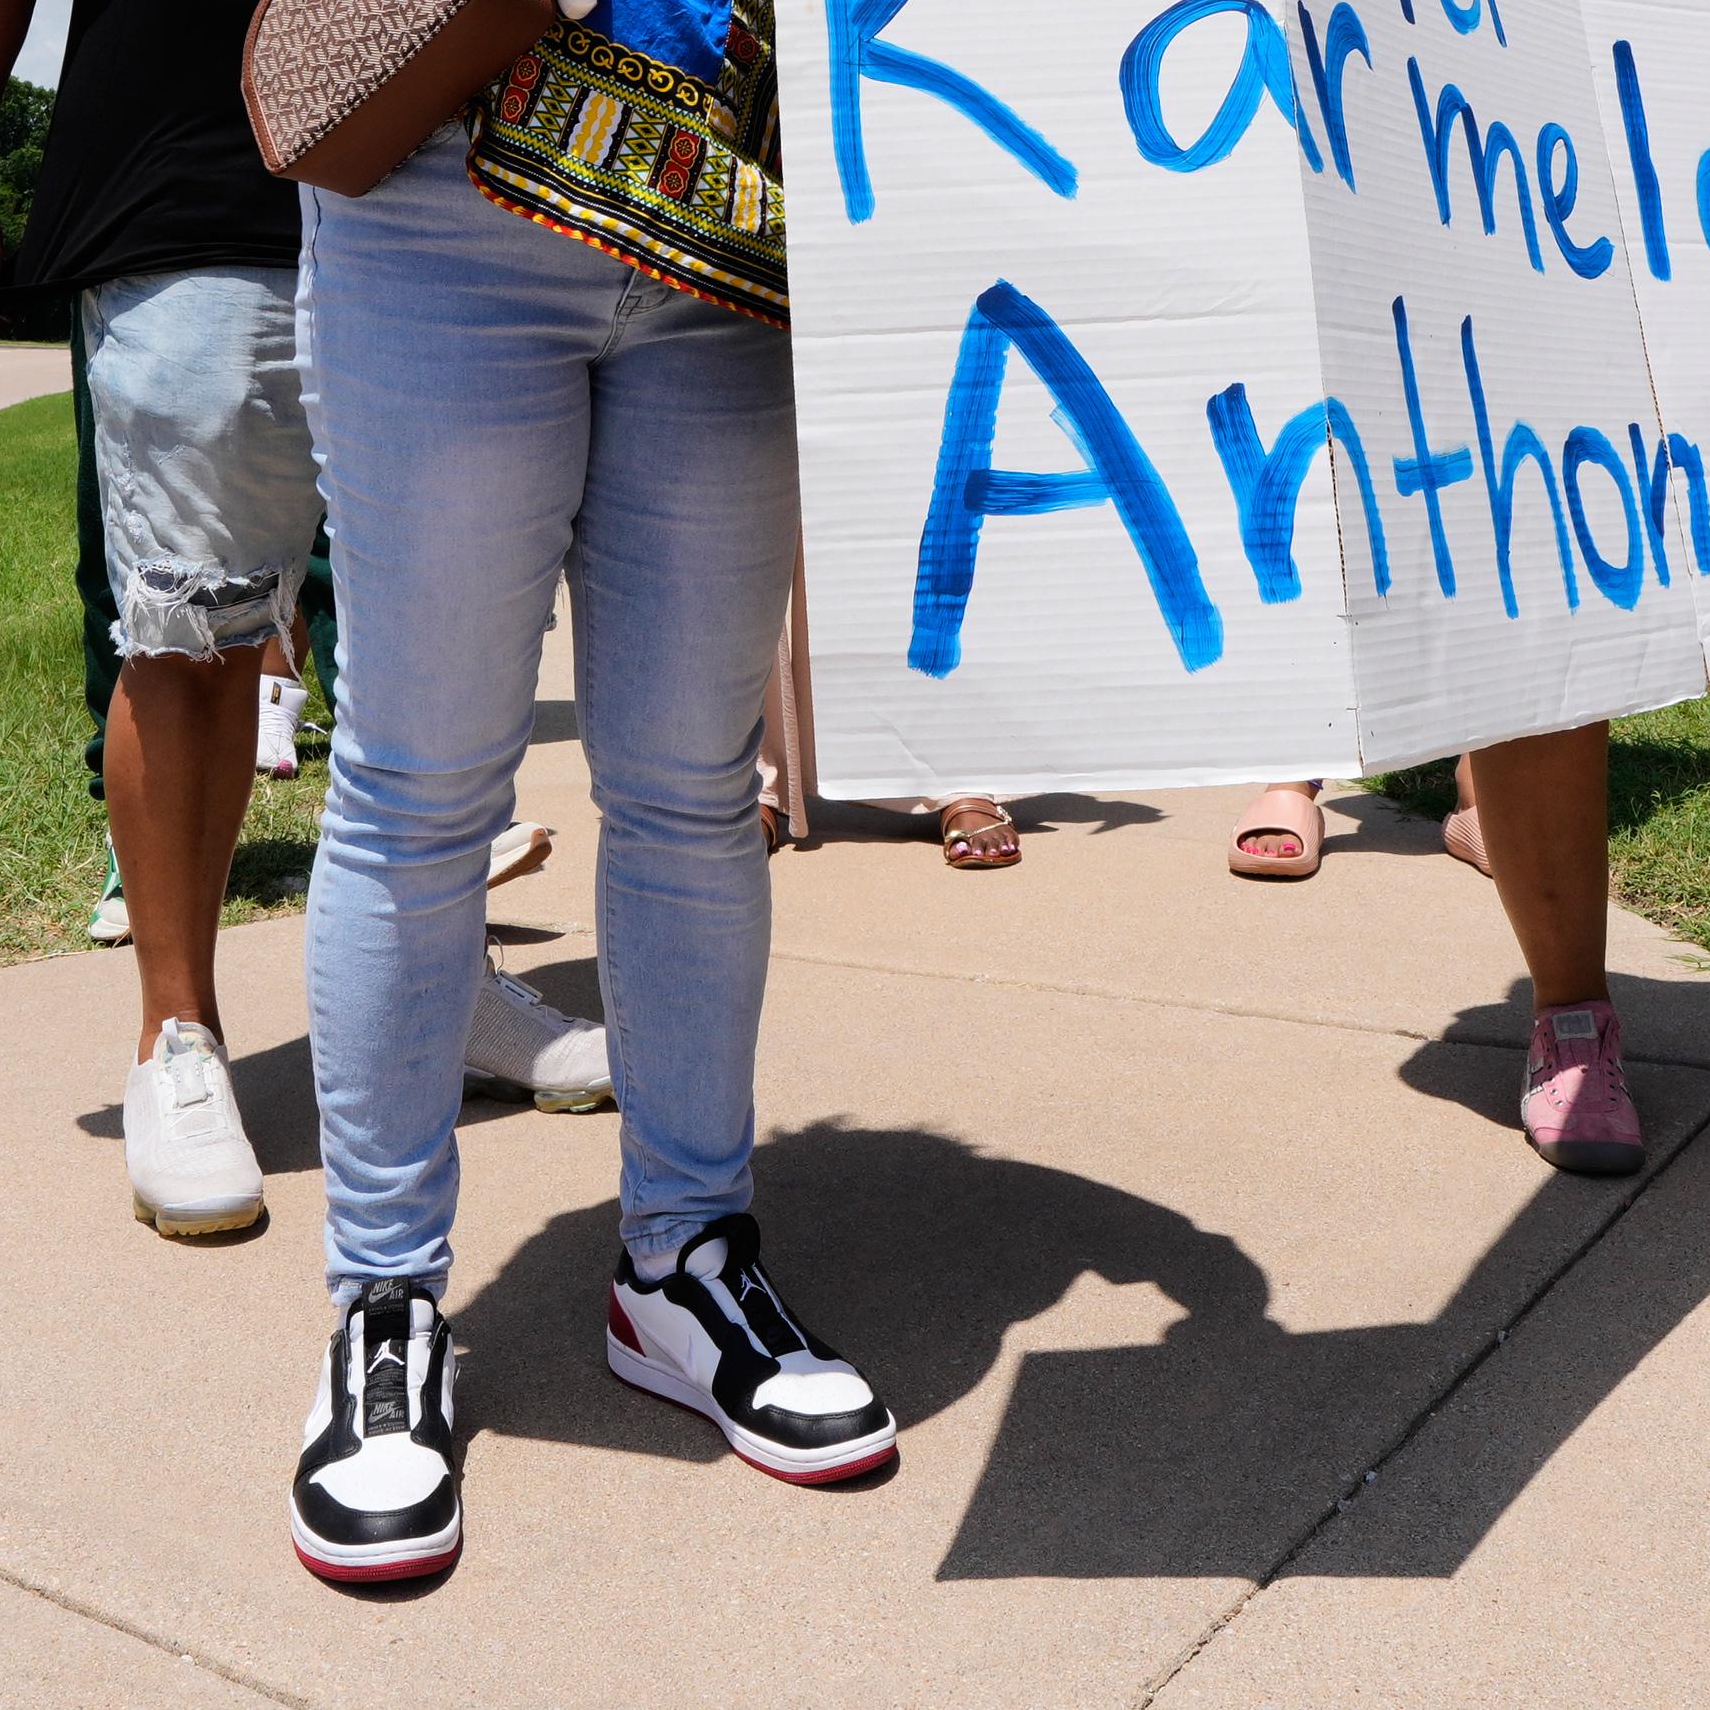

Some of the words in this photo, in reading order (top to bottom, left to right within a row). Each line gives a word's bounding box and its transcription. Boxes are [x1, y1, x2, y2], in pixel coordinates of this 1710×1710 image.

[373, 1278, 394, 1293] NIKE
[389, 1289, 404, 1300] AIR
[373, 1401, 396, 1416] NIKE
[389, 1407, 405, 1419] AIR
